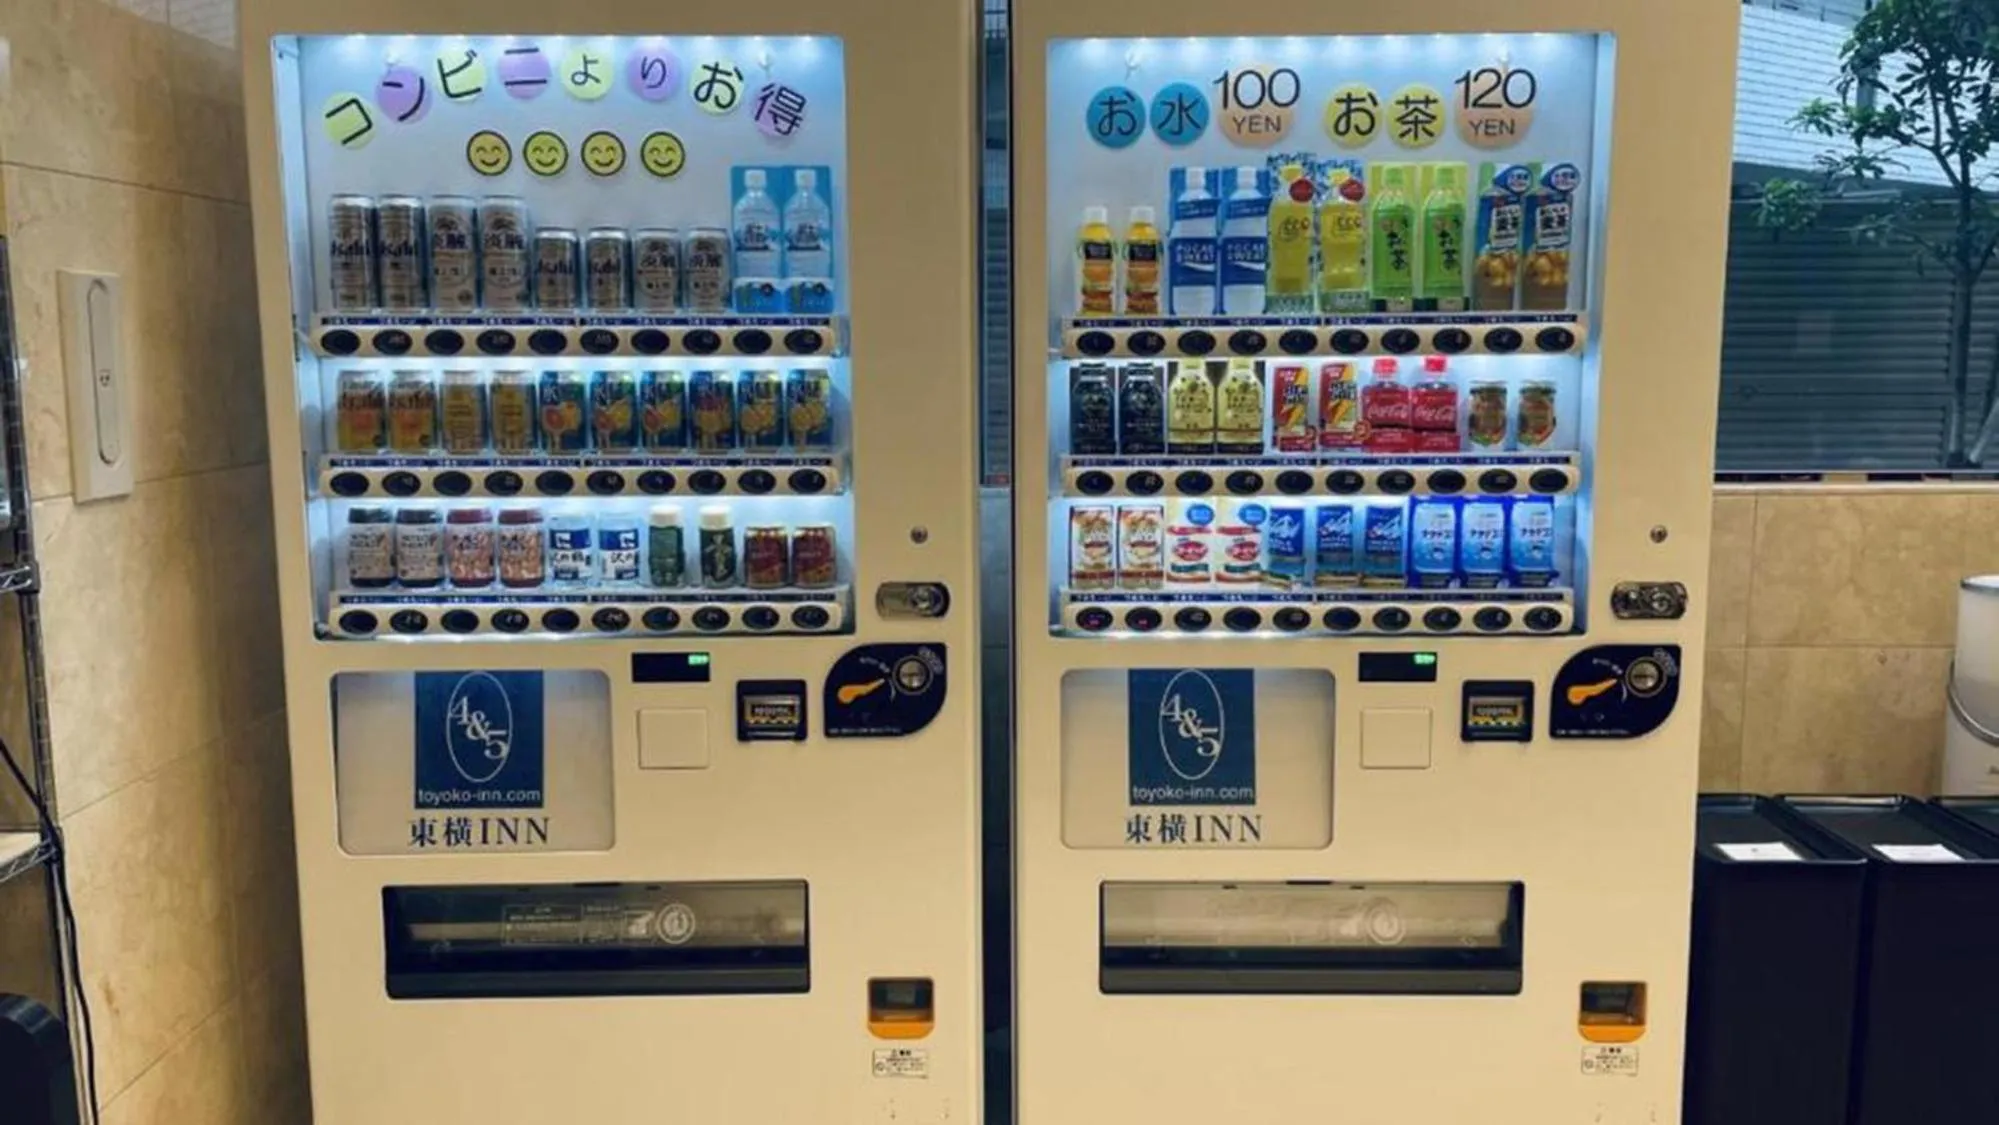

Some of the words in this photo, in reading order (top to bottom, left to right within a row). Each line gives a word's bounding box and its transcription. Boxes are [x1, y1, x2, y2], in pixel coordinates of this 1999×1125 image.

[325, 47, 807, 138] コンビニよりお得
[1098, 91, 1201, 136] お水
[1213, 67, 1300, 109] 100
[1333, 91, 1439, 140] お茶
[1454, 67, 1537, 109] 120
[1232, 115, 1281, 133] YEN
[1469, 118, 1515, 136] YEN
[450, 695, 509, 759] 4&5
[1160, 692, 1219, 757] 4&5
[418, 788, 541, 806] toyoko-inn.com
[1133, 784, 1253, 802] toyoko-inn.com
[410, 816, 549, 847] 東横INN
[1126, 813, 1262, 844] 東横INN
